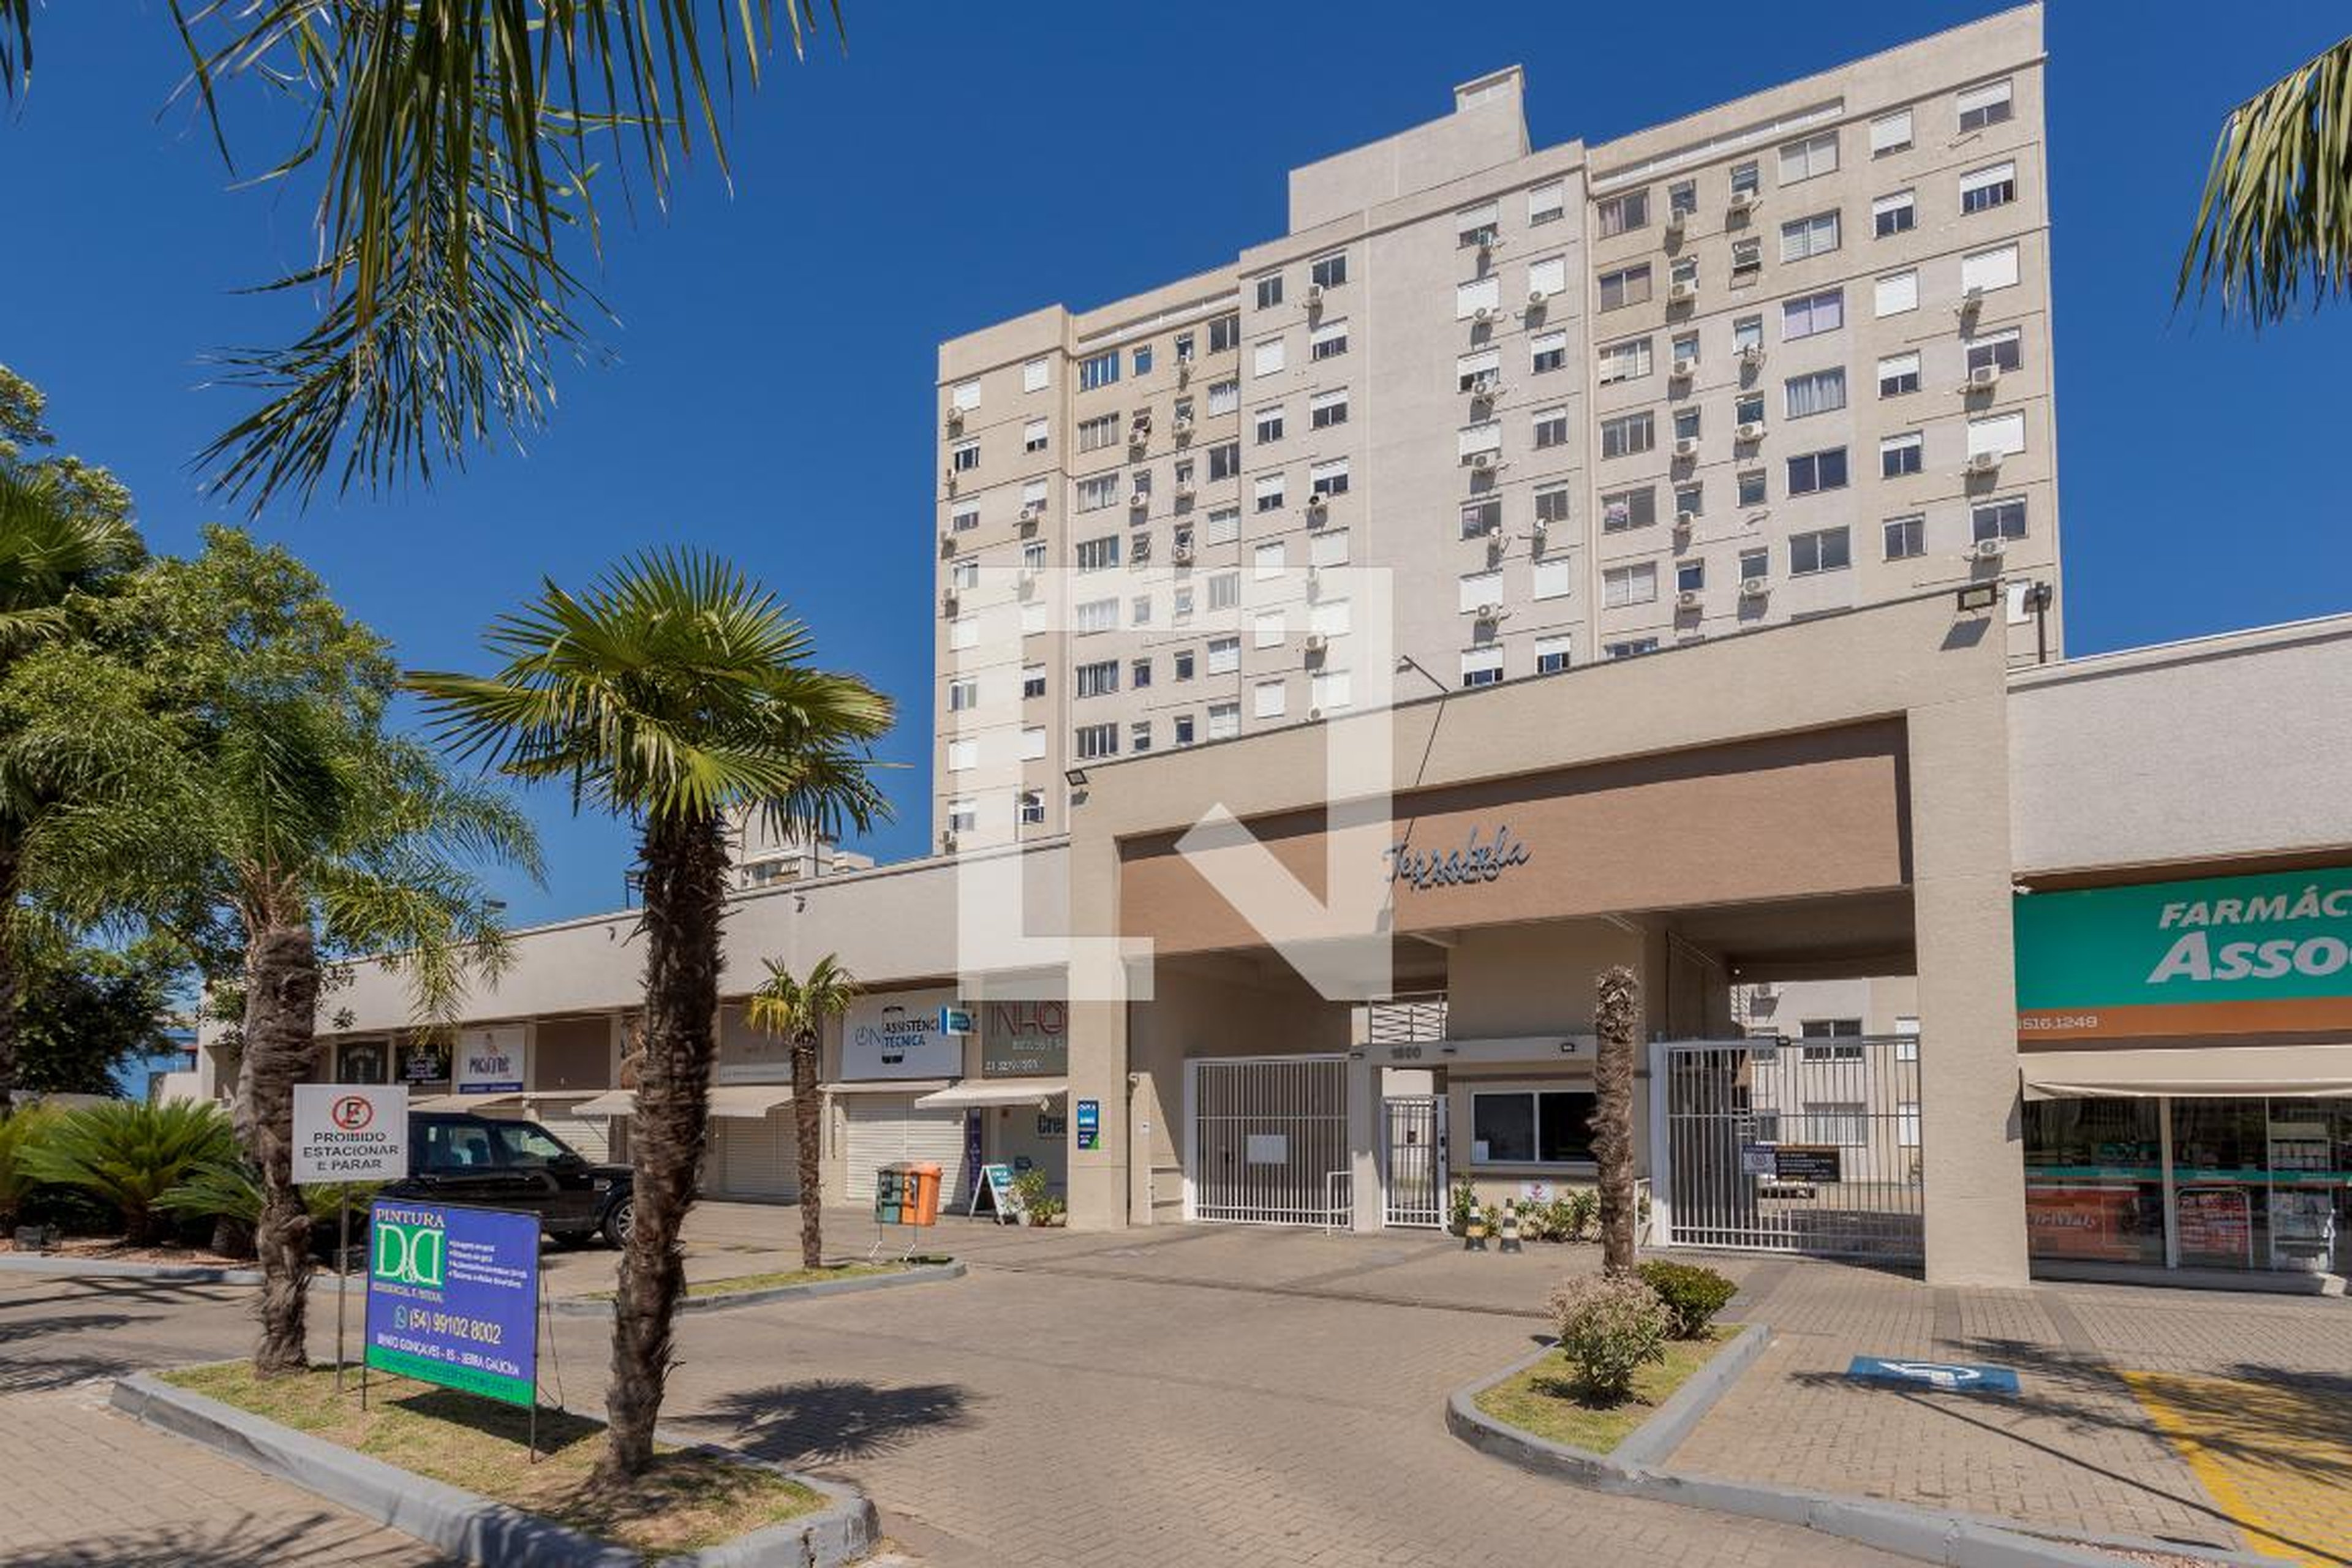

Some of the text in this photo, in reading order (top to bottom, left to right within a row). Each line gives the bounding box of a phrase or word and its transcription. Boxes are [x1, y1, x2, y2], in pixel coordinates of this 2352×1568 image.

[2159, 885, 2352, 929] FARMÁC
[314, 1133, 386, 1144] PROIBIDO
[303, 1145, 399, 1158] ESTACIONAR
[317, 1159, 382, 1170] E PARAR
[375, 1208, 445, 1228] PINTURA
[409, 1308, 431, 1335] (54)
[432, 1312, 469, 1339] 99102
